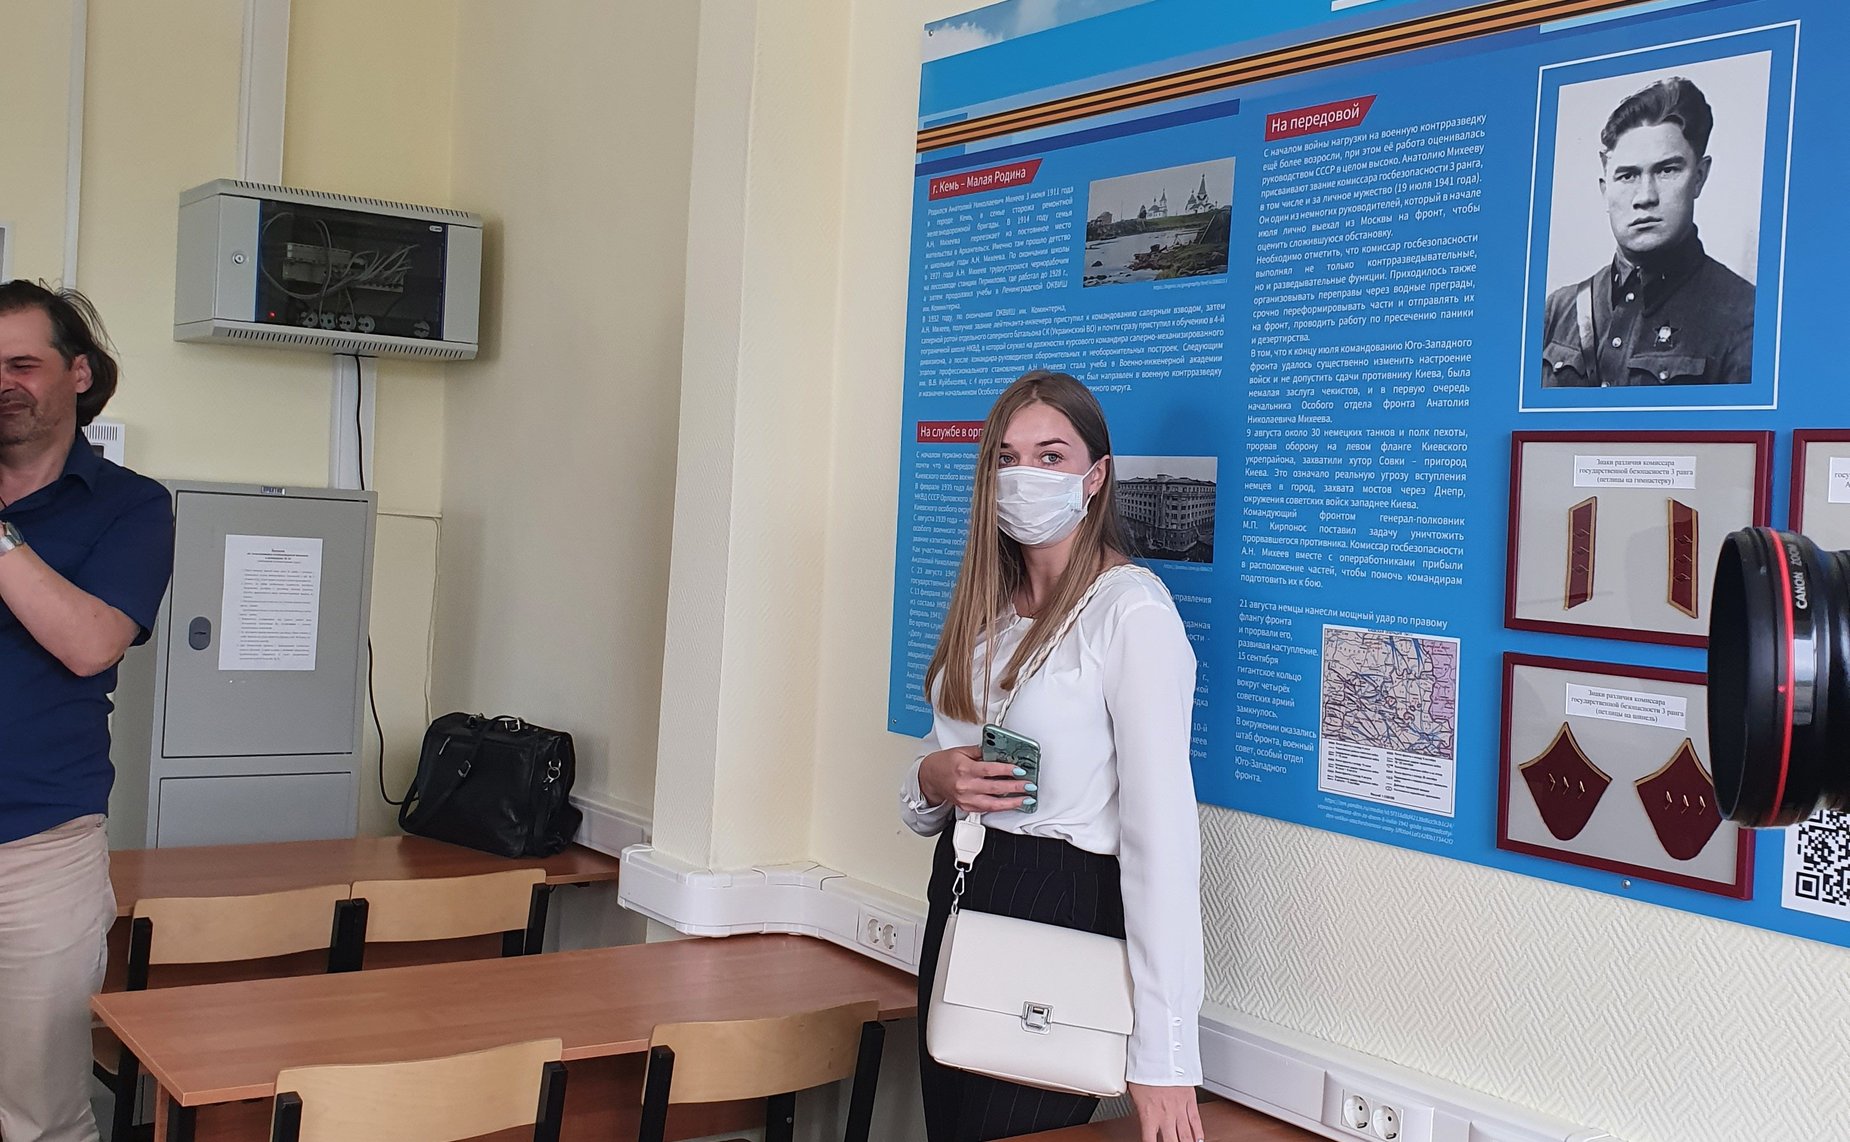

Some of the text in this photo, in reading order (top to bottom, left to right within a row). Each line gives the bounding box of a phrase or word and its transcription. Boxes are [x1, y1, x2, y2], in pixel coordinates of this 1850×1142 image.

[1271, 102, 1359, 133] На передовой
[1270, 144, 1302, 156] началом
[1304, 139, 1329, 151] войны
[1330, 134, 1367, 146] нагрузки
[1369, 132, 1379, 140] на
[1381, 125, 1418, 138] военную
[1419, 114, 1486, 132] контрразведку
[932, 184, 937, 194] г.
[939, 180, 959, 192] Кемь
[966, 174, 992, 187] Малая
[994, 168, 1025, 184] Родина
[1258, 202, 1480, 237] июля лично выехал из Москвы на фронт, чтобы
[1256, 234, 1478, 264] Необходимо отметить, что комиссар госбезопасности
[1263, 321, 1290, 331] фронт,
[1293, 318, 1335, 330] проводить
[1338, 314, 1367, 327] работу
[1369, 315, 1380, 323] по
[1384, 311, 1436, 324] пресечению
[1440, 309, 1473, 318] паники
[1100, 372, 1133, 380] направлен
[1141, 370, 1169, 379] военную
[1171, 368, 1222, 378] контрразведку
[1247, 398, 1469, 410] начальника Особого отдела фронта Анатолия
[920, 425, 930, 437] На
[931, 425, 960, 439] службе
[967, 427, 984, 439] орг
[1246, 443, 1277, 451] прорвав
[1285, 440, 1318, 452] оборону
[1380, 441, 1411, 452] фланге
[1421, 441, 1467, 451] Киевского
[1834, 472, 1850, 480] госу
[1243, 507, 1464, 525] Командующий фронтом генерал-полковник
[1242, 520, 1464, 540] М.П. Кирпонос поставил задачу уничтожить
[1249, 561, 1304, 572] расположение
[1307, 565, 1336, 576] частей,
[1341, 567, 1366, 577] чтобы
[1371, 570, 1402, 580] помочь
[1407, 574, 1462, 586] командирам
[1787, 544, 1808, 610] CANON ZOOM
[1238, 612, 1291, 625] флангу фронта
[1239, 598, 1447, 630] 21 августа немцы нанесли мощный удар по правому
[1244, 627, 1278, 637] прорвали
[1279, 631, 1292, 640] его,
[1237, 639, 1318, 656] развивая наступление.
[1238, 651, 1278, 666] 15 сентября
[1237, 665, 1301, 682] гигантское кольцо
[1236, 678, 1290, 693] вокруг четырёх
[1236, 692, 1294, 707] советских армий
[1236, 705, 1278, 718] замкнулось.
[1241, 719, 1279, 731] окружении
[1280, 726, 1316, 738] оказались
[1235, 731, 1314, 751] штаб фронта, военный
[1235, 744, 1303, 763] совет, особый отдел
[1234, 756, 1286, 773] Юго-Западного
[1234, 768, 1261, 782] фронта.
